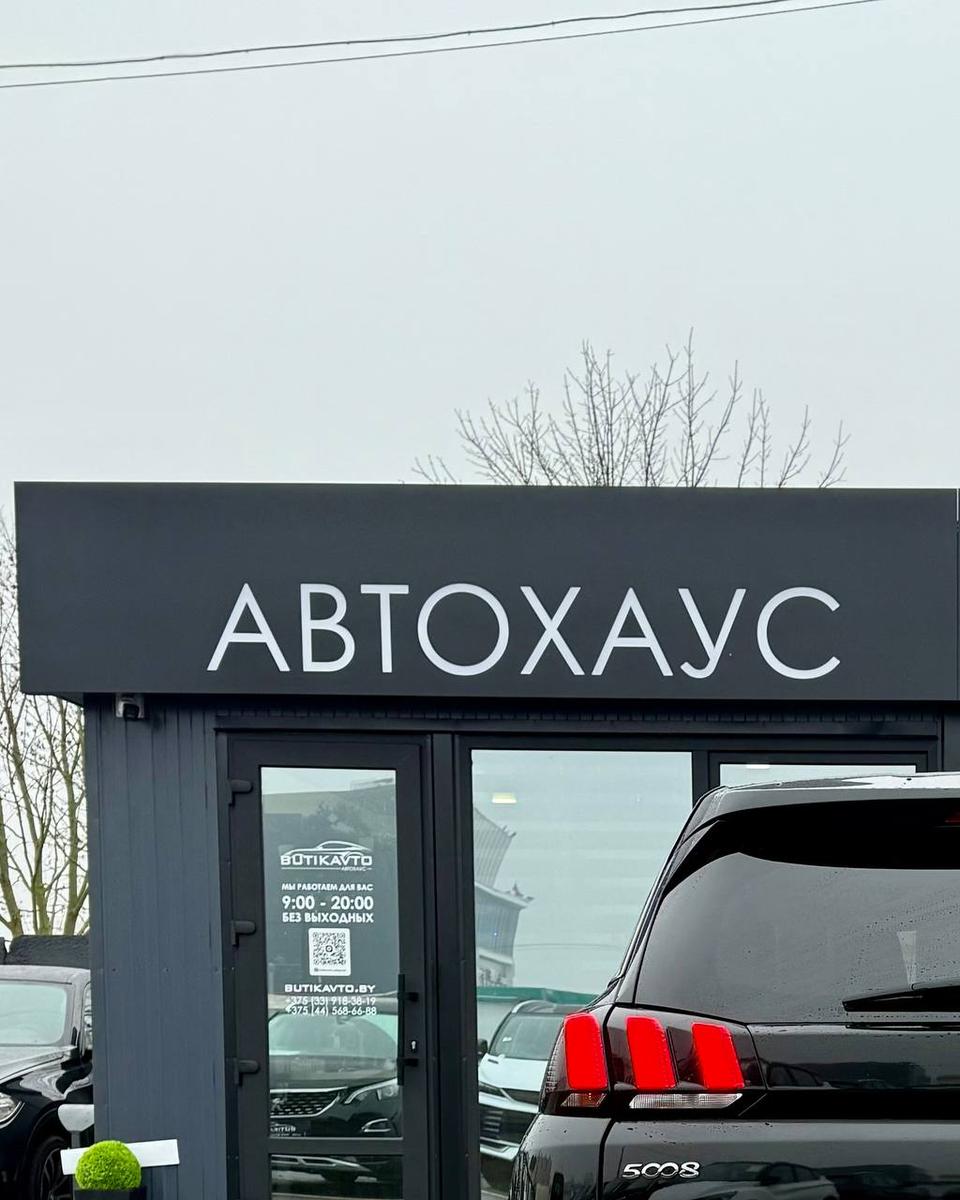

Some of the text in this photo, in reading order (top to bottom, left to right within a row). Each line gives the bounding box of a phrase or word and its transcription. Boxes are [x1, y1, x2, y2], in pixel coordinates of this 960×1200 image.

[206, 583, 841, 681] АВТОХАУС
[280, 855, 373, 866] BUTIKAVTO
[281, 883, 374, 892] МЫ РАБОТАЕМ ДЛЯ ВАС
[281, 895, 315, 910] 9:00
[331, 895, 374, 910] 20:00
[282, 912, 375, 924] БЕЗ ВЫХОДНЫХ
[284, 983, 376, 993] BUTIKAVTO.BY
[311, 996, 329, 1007] (33)
[332, 996, 377, 1006] 918-38-19
[311, 1006, 329, 1017] (44)
[331, 1006, 377, 1016] 568-66-88
[622, 1161, 701, 1179] 5008
